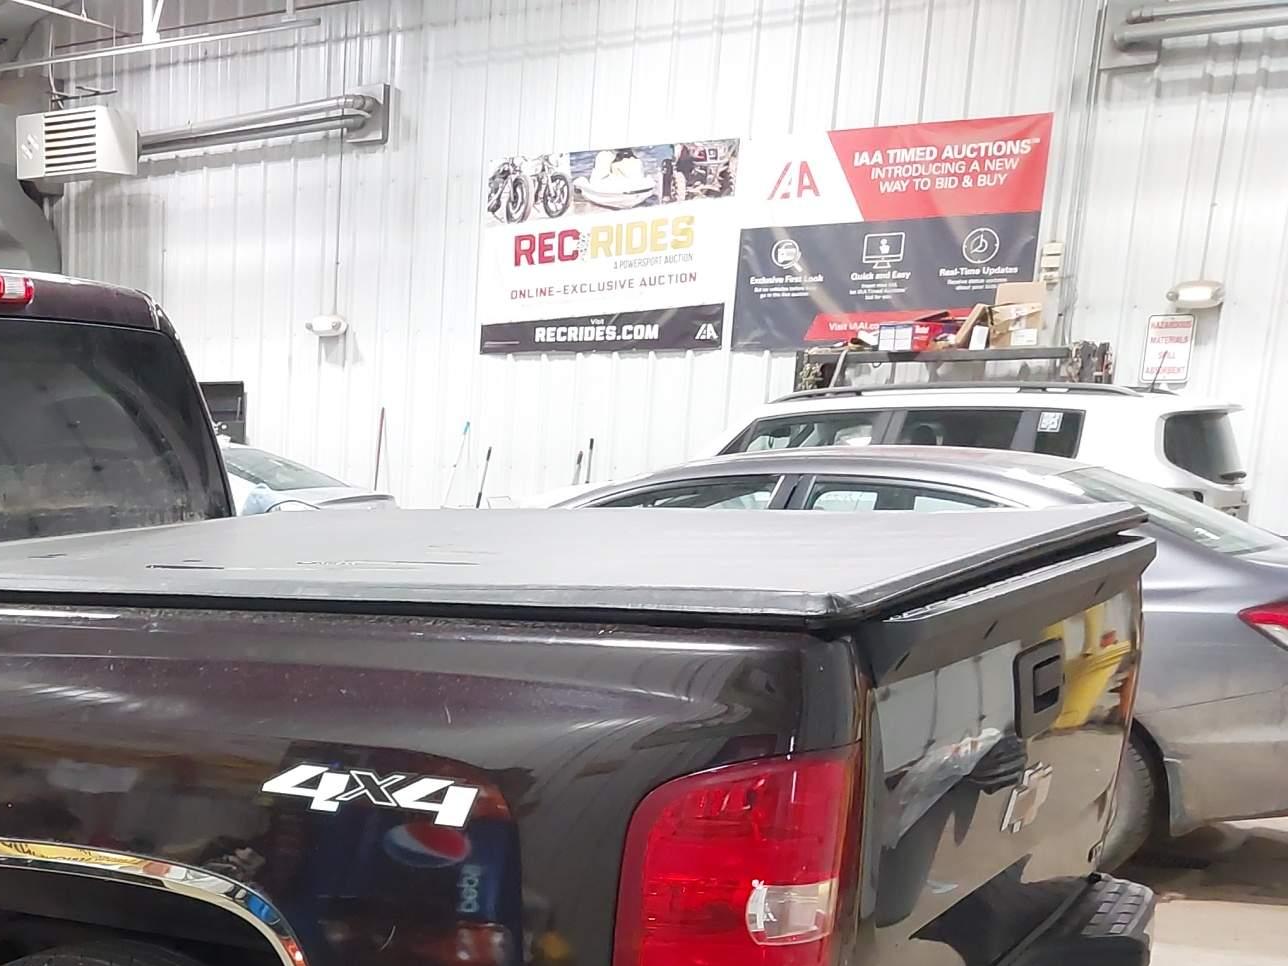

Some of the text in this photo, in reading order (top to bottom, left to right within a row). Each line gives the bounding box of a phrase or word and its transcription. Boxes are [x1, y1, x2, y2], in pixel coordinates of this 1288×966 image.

[853, 149, 884, 167] IAA
[886, 146, 937, 165] TIMED
[871, 158, 1020, 179] INTRODUCING A NEW
[879, 173, 1009, 194] WAY TO BID & BUY
[619, 255, 663, 270] POWERSPORT
[663, 252, 694, 265] AUCTION
[750, 273, 824, 285] Exclusive First Look
[850, 270, 912, 280] Quick and Easy
[939, 266, 1019, 277] Real-Time Updates
[510, 272, 698, 301] ONLINE-EXCLUSIVE AUCTION
[534, 324, 659, 343] RECRIDES.COM
[829, 322, 848, 331] Visit
